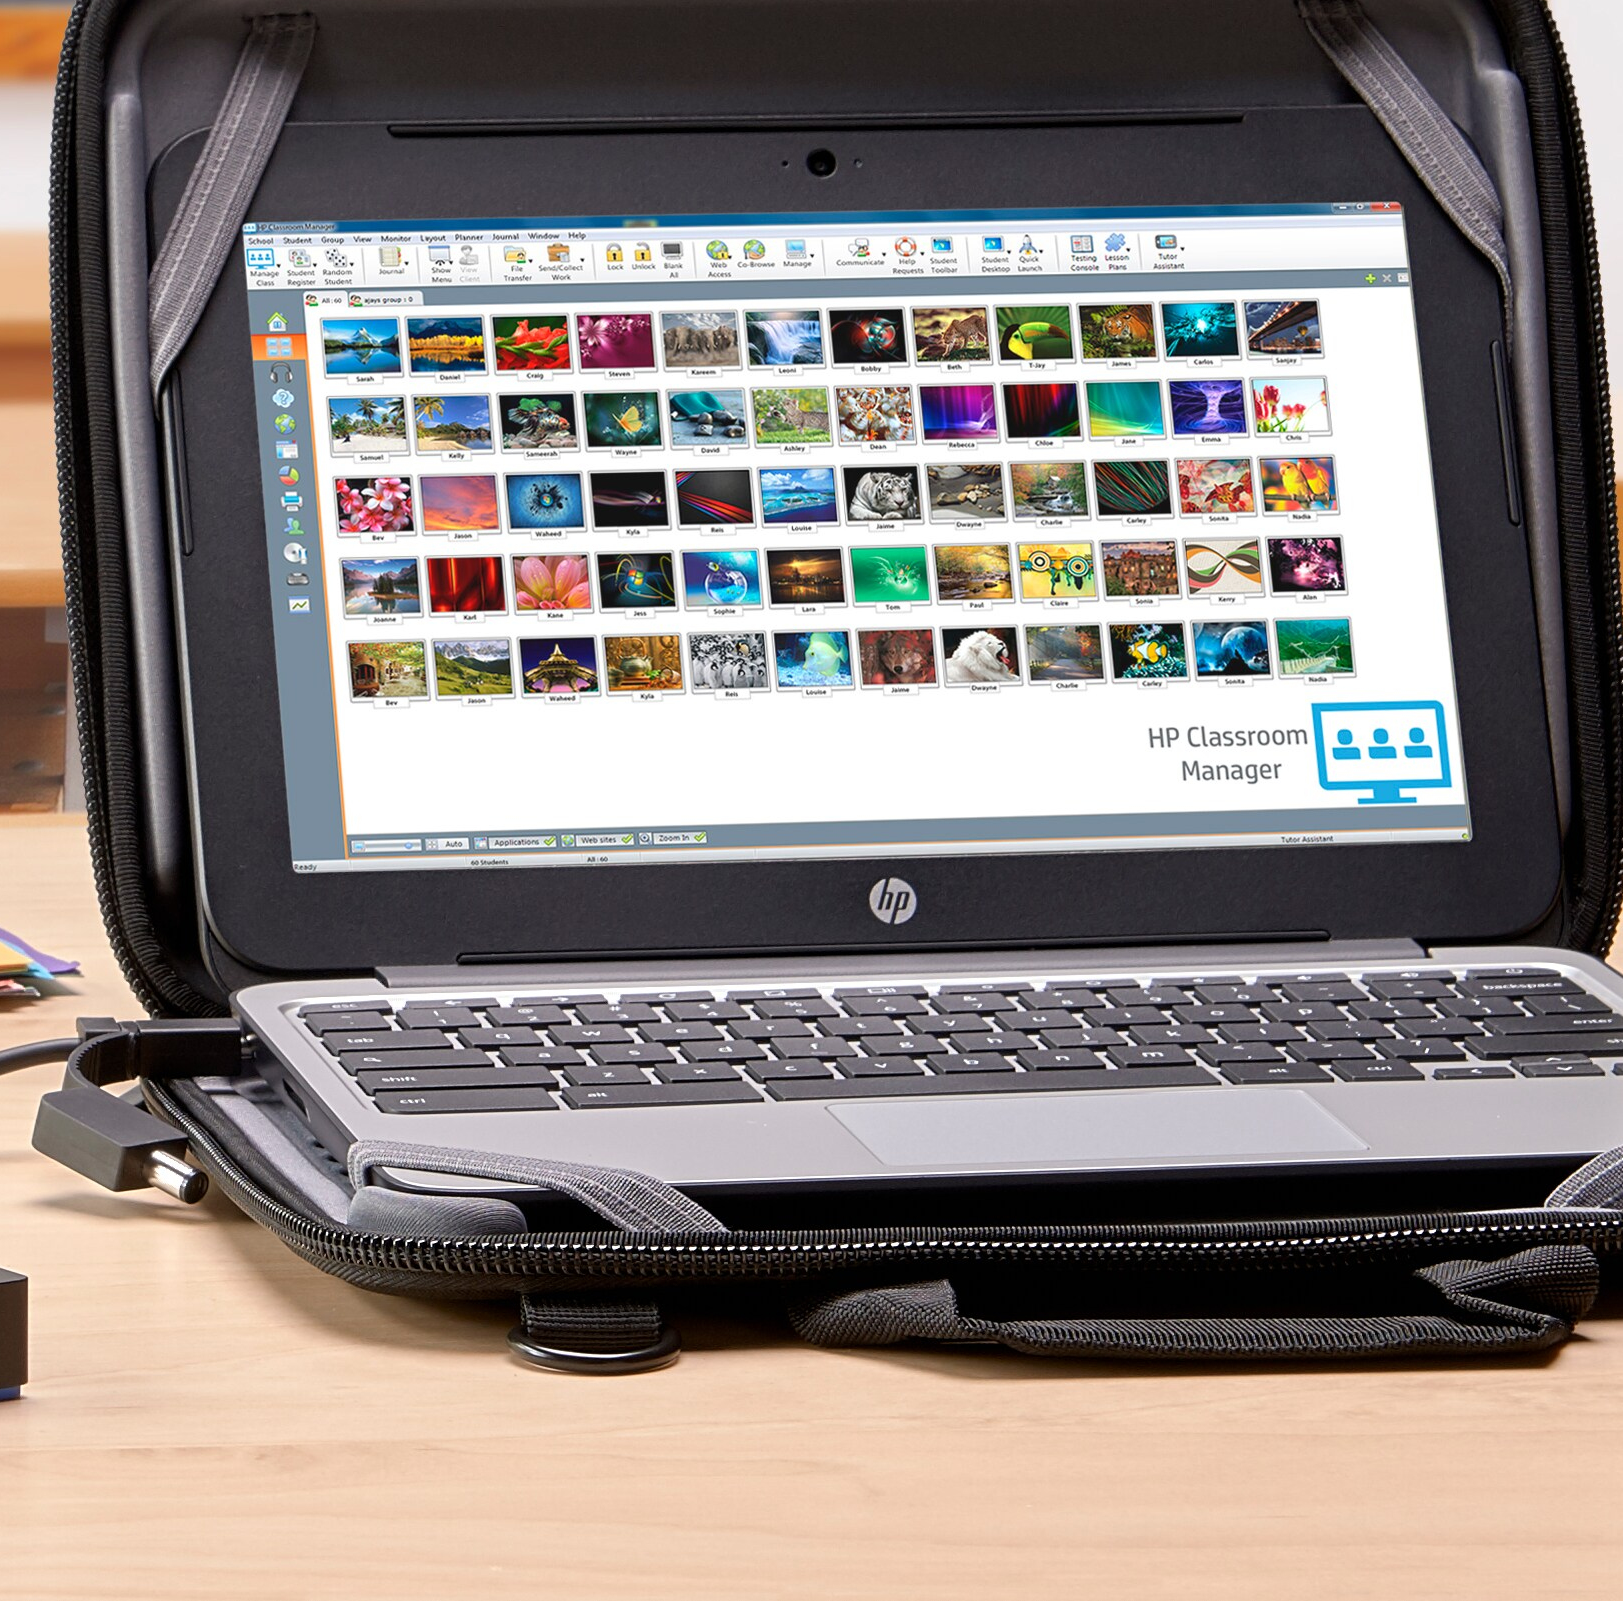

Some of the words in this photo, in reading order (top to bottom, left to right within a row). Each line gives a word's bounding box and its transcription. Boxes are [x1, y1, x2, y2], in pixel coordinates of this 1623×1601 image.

[257, 223, 267, 231] HP
[268, 222, 303, 231] Classroom
[304, 221, 335, 232] Manager
[321, 236, 344, 245] Group
[420, 235, 446, 243] Layout
[454, 233, 483, 241] Planner
[568, 232, 586, 240] Help
[287, 279, 315, 287] Register
[1149, 727, 1179, 748] HP
[1188, 726, 1307, 747] Classroom
[1182, 761, 1282, 784] Manager
[1302, 836, 1334, 844] Assistant
[293, 863, 317, 872] Ready
[873, 877, 914, 925] hp
[1482, 981, 1563, 991] backspace
[1573, 1017, 1613, 1025] enter
[348, 1036, 374, 1045] tab
[382, 1074, 418, 1084] shift
[400, 1098, 426, 1106] ctrl
